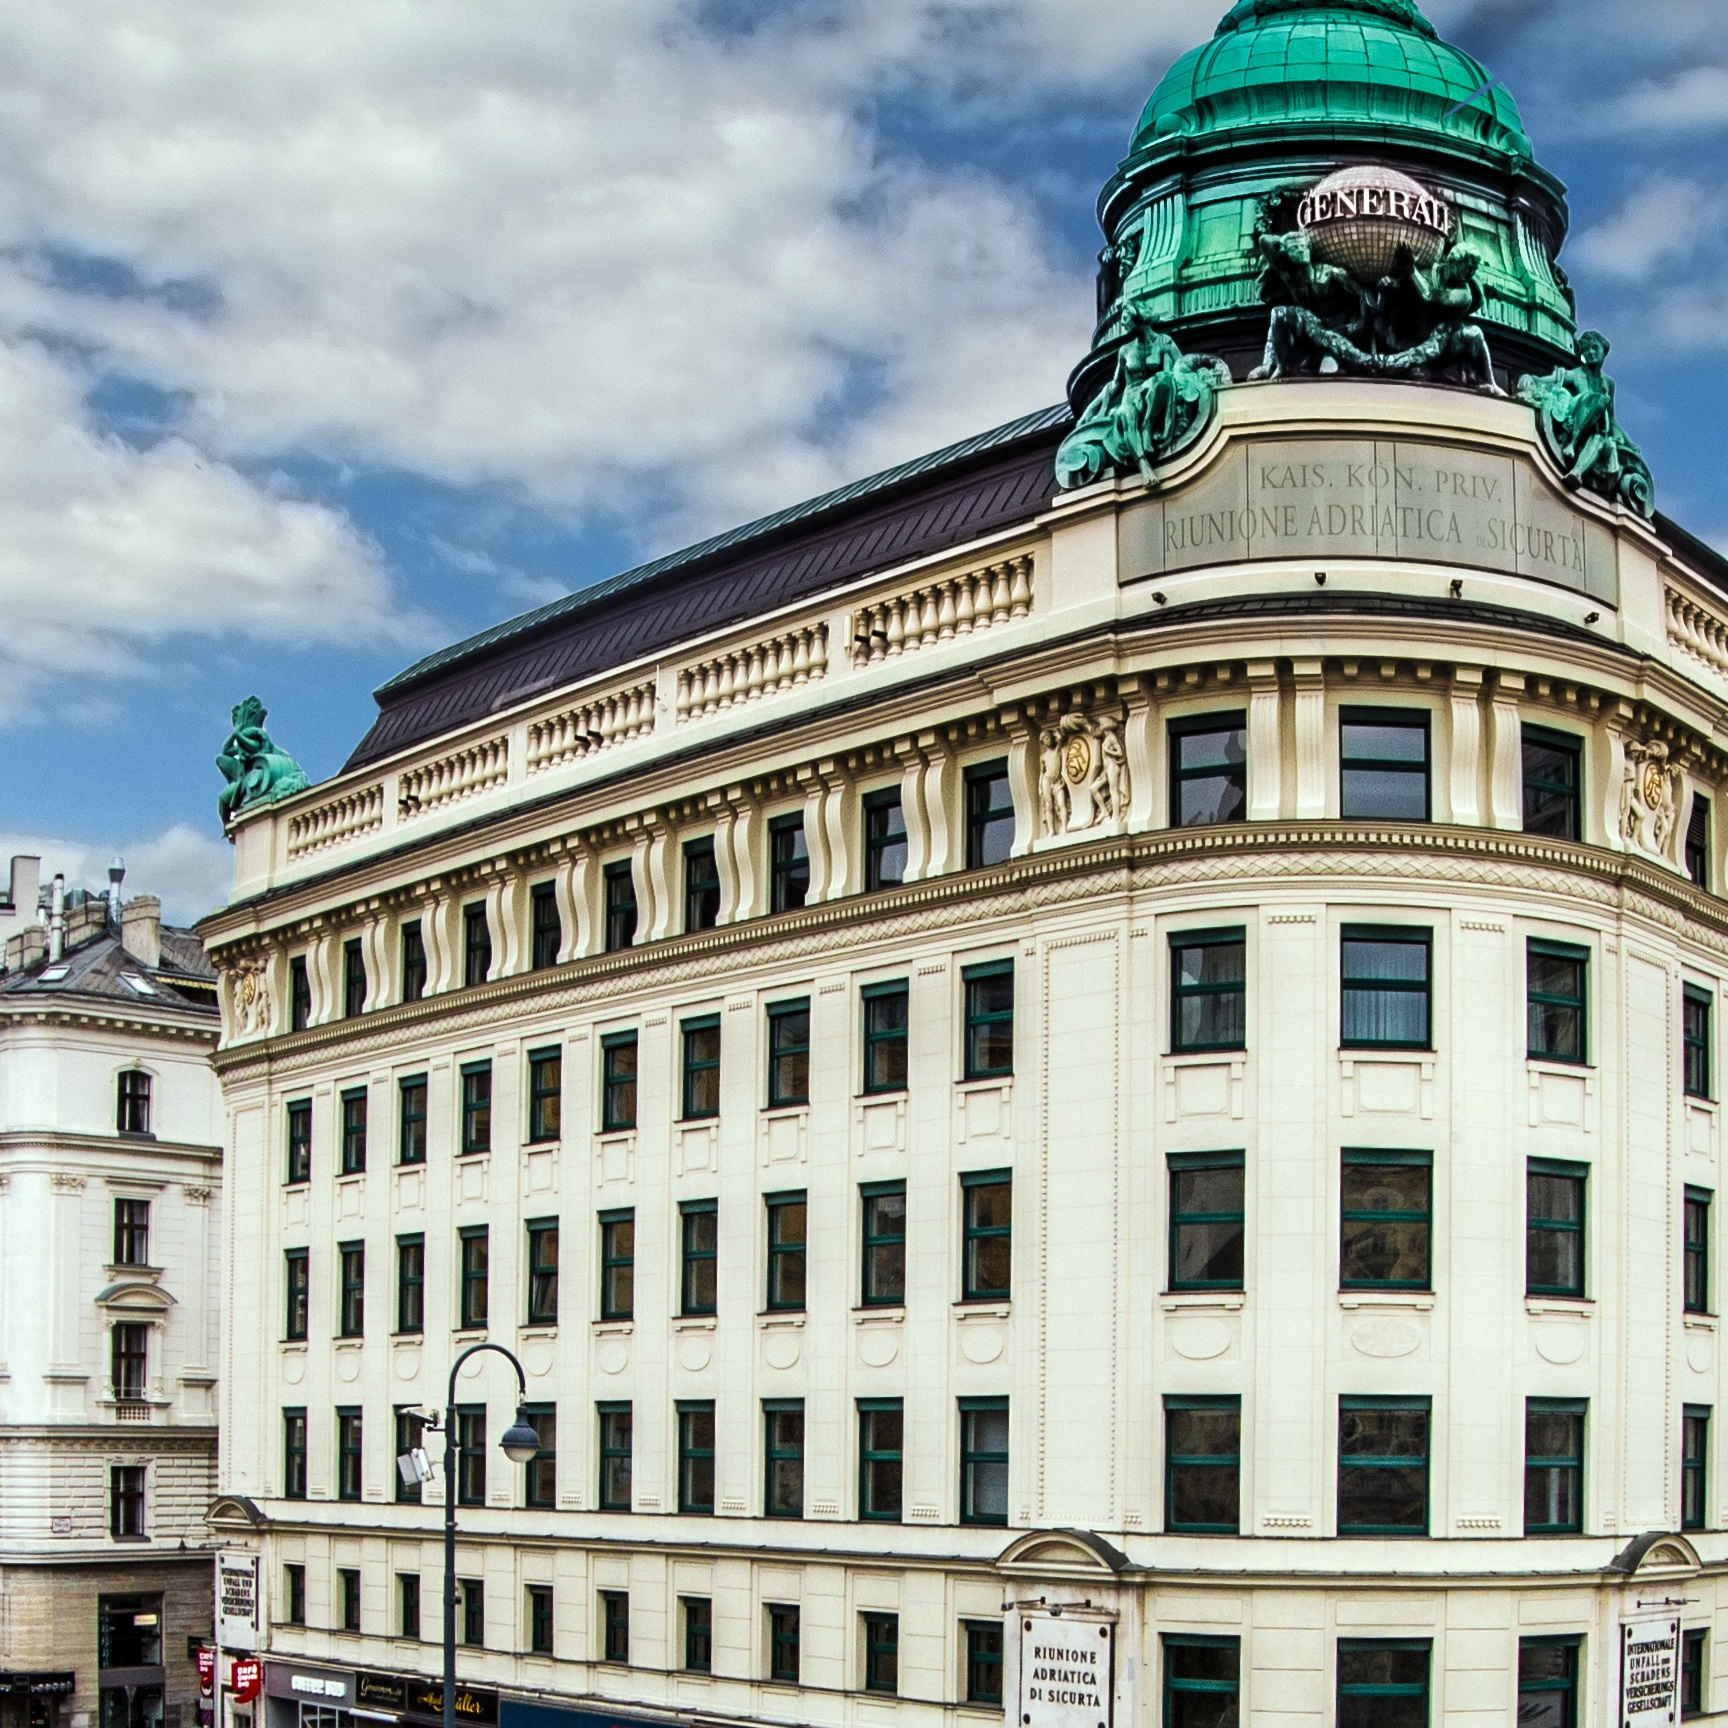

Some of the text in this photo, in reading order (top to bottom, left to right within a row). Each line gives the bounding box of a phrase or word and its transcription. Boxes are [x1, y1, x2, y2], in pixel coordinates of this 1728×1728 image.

[1297, 187, 1452, 235] GENERALI
[1260, 464, 1333, 490] KAIS.
[1435, 470, 1503, 503] PRIV.
[1164, 505, 1299, 552] RIUNIONE
[1307, 504, 1463, 543] ADRIATICA
[1034, 1647, 1097, 1664] RIUNIONE
[1627, 1637, 1675, 1656] INTERNATIONALE
[1630, 1654, 1660, 1670] UNFALL
[1033, 1668, 1097, 1685] ADRIATICA
[1630, 1667, 1671, 1685] SCHADENS
[1030, 1687, 1101, 1707] DI SICURTA
[1626, 1681, 1674, 1699] VERSICHERUNGS
[1627, 1695, 1672, 1714] GESELLSCHAFT
